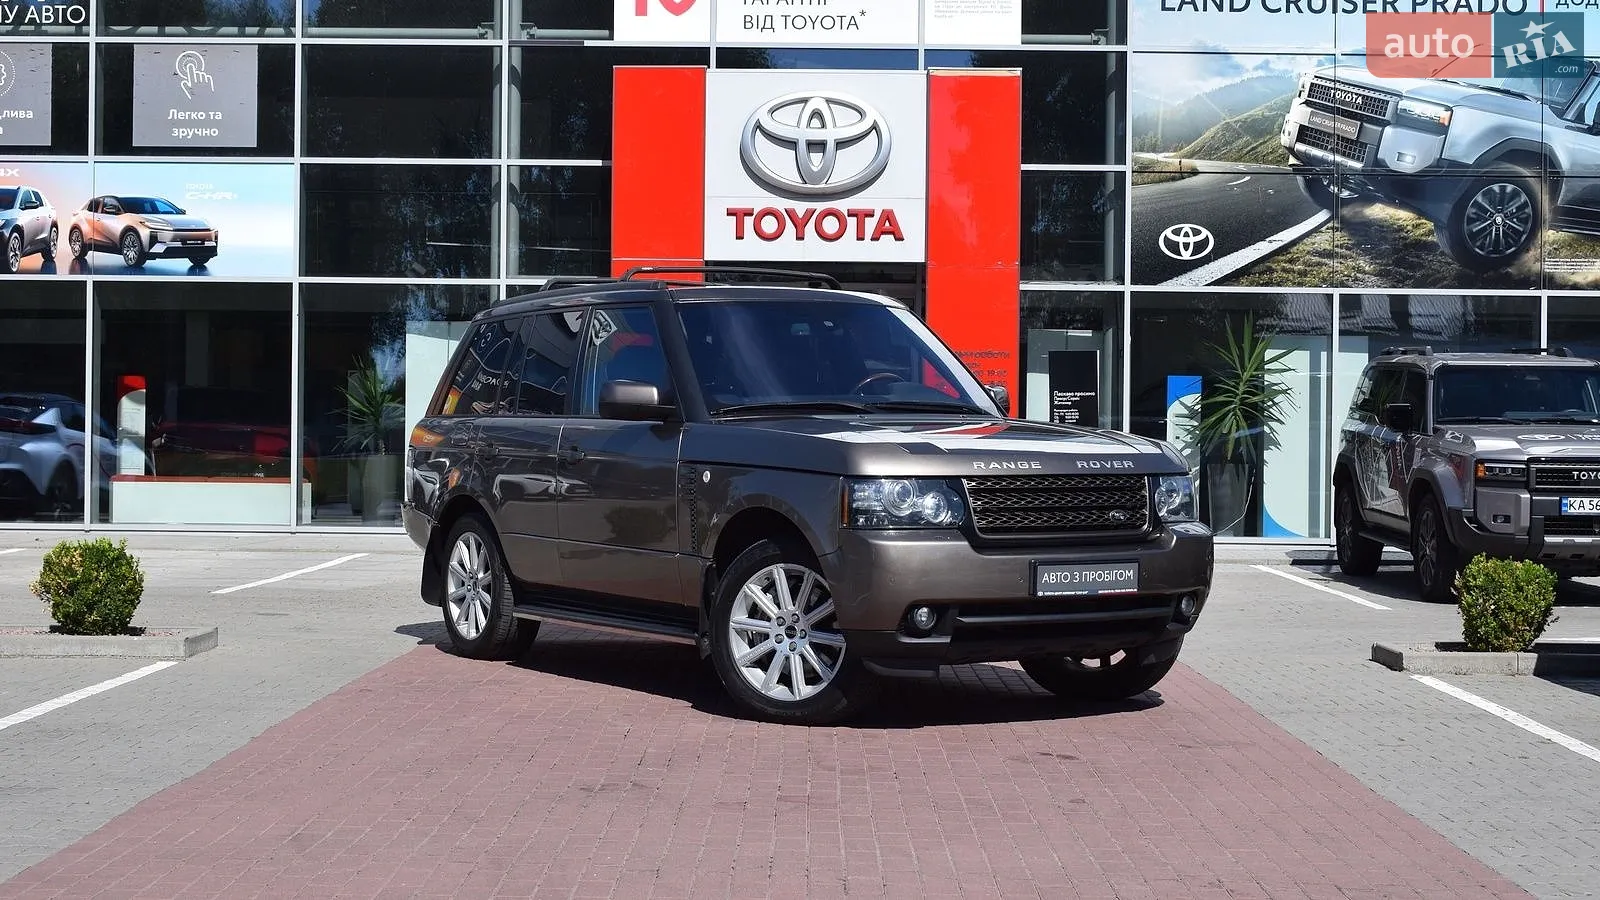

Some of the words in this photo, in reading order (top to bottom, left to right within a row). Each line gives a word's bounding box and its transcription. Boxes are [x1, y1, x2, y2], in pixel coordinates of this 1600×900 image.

[0, 5, 19, 24] У
[24, 5, 86, 24] АВТО
[743, 14, 775, 33] ВІД
[1330, 89, 1363, 105] TOYOTA
[0, 110, 34, 120] лива
[167, 109, 206, 120] Легко
[208, 111, 222, 120] та
[171, 127, 219, 139] зручно
[726, 206, 905, 242] TOYOTA
[972, 461, 1042, 470] RANGE
[1076, 460, 1135, 468] ROVER
[1568, 499, 1586, 511] KA
[1041, 572, 1071, 584] АВТО
[1082, 569, 1134, 582] ПРОБІГОМ
